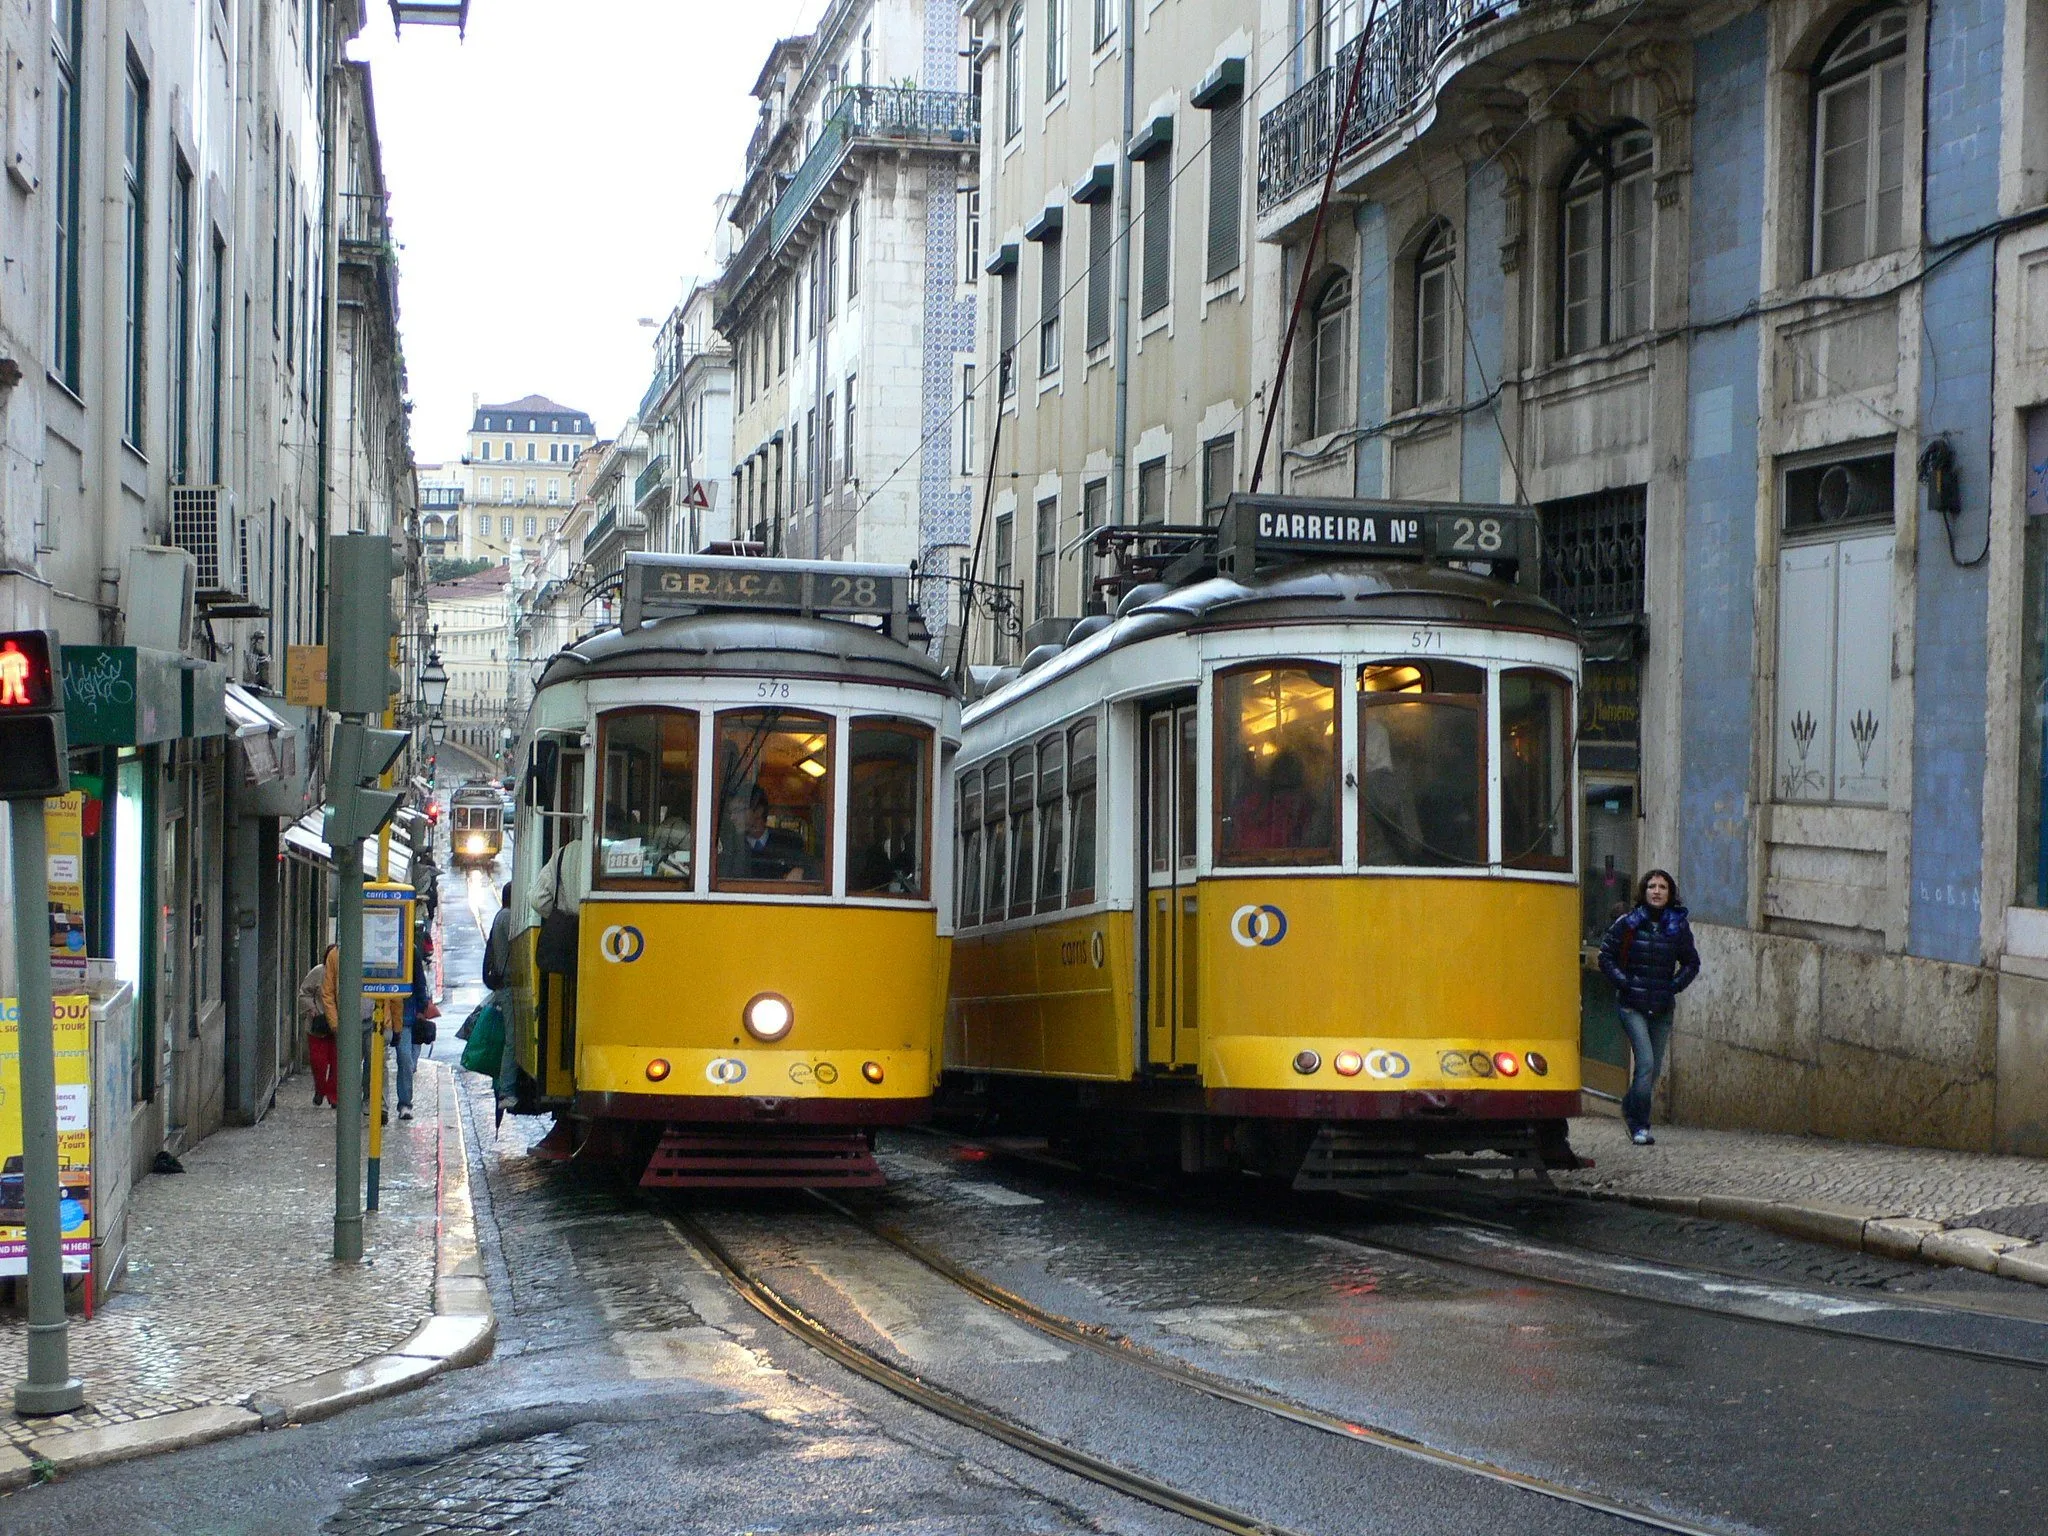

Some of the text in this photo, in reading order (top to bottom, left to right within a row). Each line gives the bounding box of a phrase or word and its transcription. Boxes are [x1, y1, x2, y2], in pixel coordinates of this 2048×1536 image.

[1259, 512, 1502, 551] CARREIRA Nº 28
[659, 571, 877, 607] GRAÇA 28
[1411, 631, 1442, 648] 571
[757, 682, 789, 698] 578
[365, 890, 388, 899] carris
[363, 984, 386, 992] carris
[61, 1022, 86, 1031] TOURS
[66, 1131, 85, 1140] with
[62, 1141, 86, 1149] Tours
